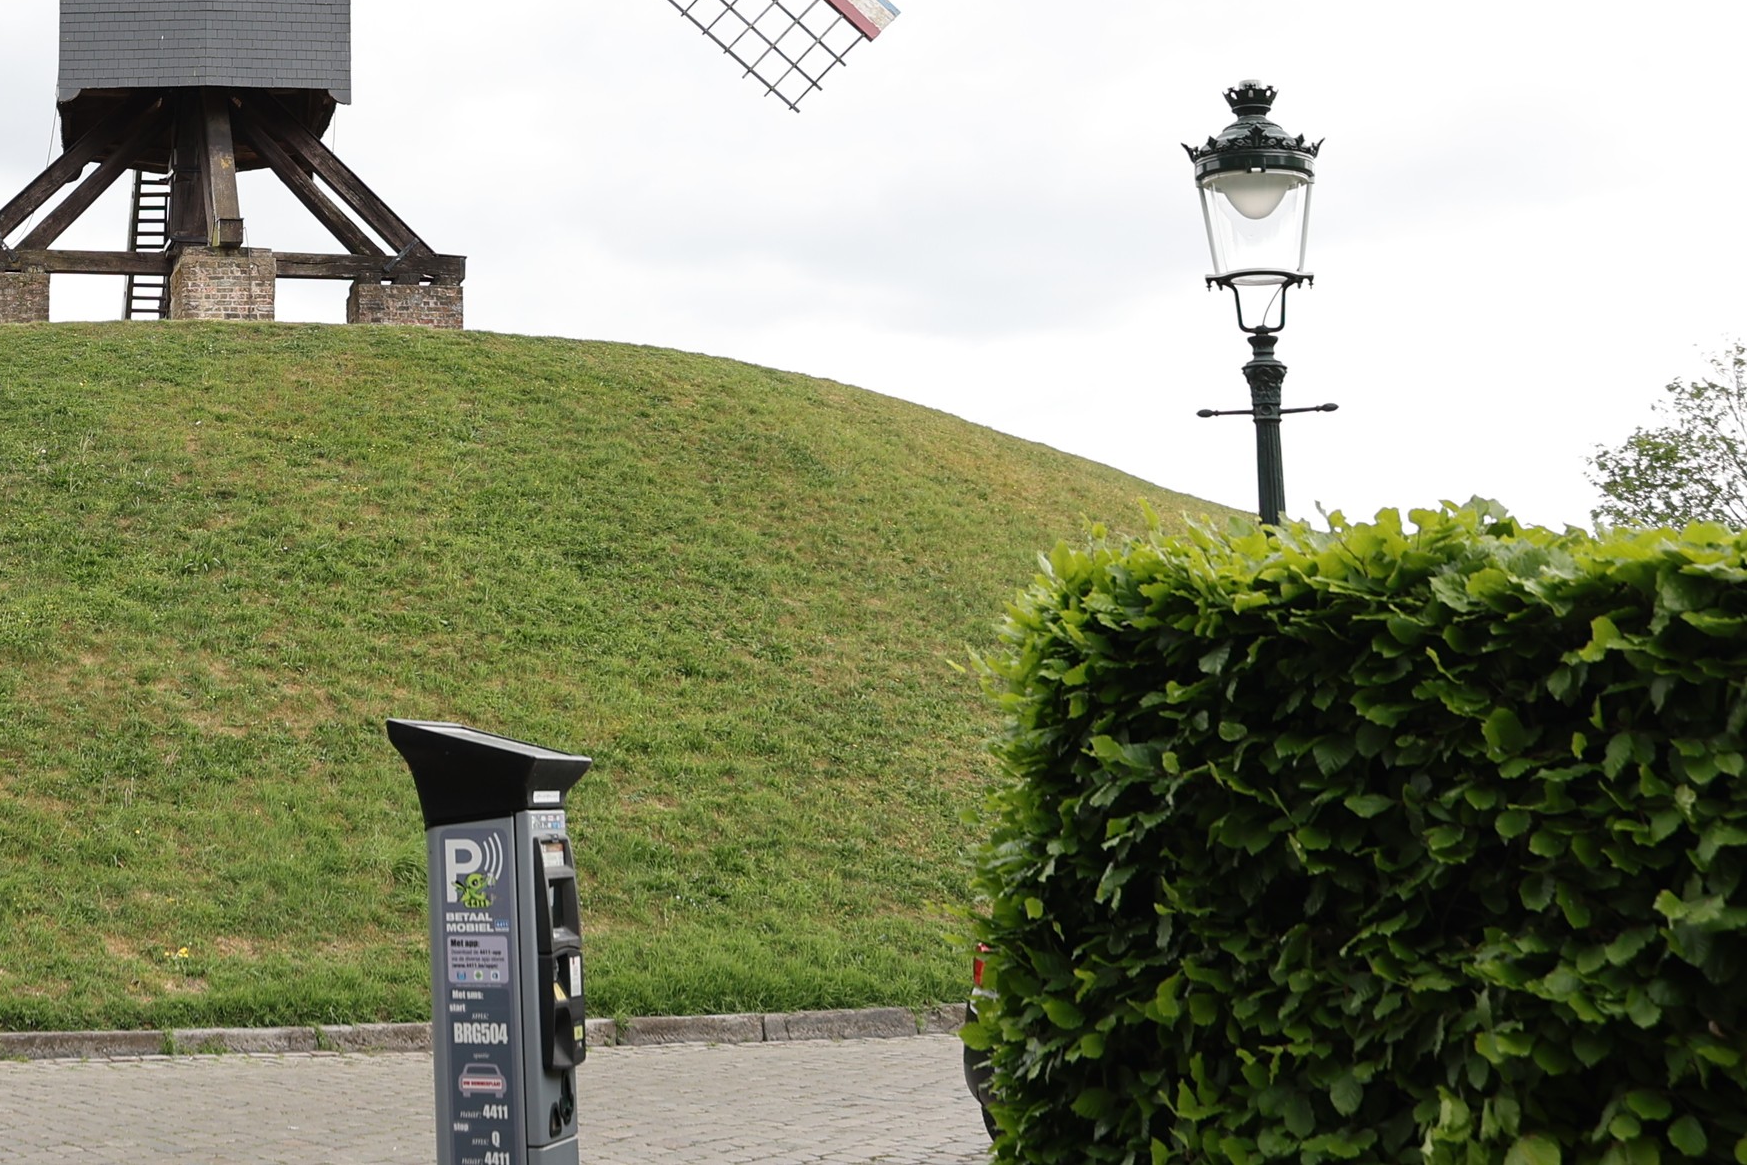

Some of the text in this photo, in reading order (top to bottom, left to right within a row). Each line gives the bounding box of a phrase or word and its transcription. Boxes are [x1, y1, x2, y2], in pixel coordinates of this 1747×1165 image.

[445, 838, 483, 903] P
[446, 912, 493, 922] BETAAL
[446, 923, 494, 933] MOBIEL
[450, 939, 464, 947] Met
[452, 989, 484, 1000] Met sms:
[449, 1003, 466, 1013] start
[454, 1022, 508, 1045] BRG504
[460, 1104, 508, 1120] naar: 4411
[453, 1122, 469, 1132] stop
[492, 1130, 500, 1148] Q
[484, 1151, 510, 1165] 4411
